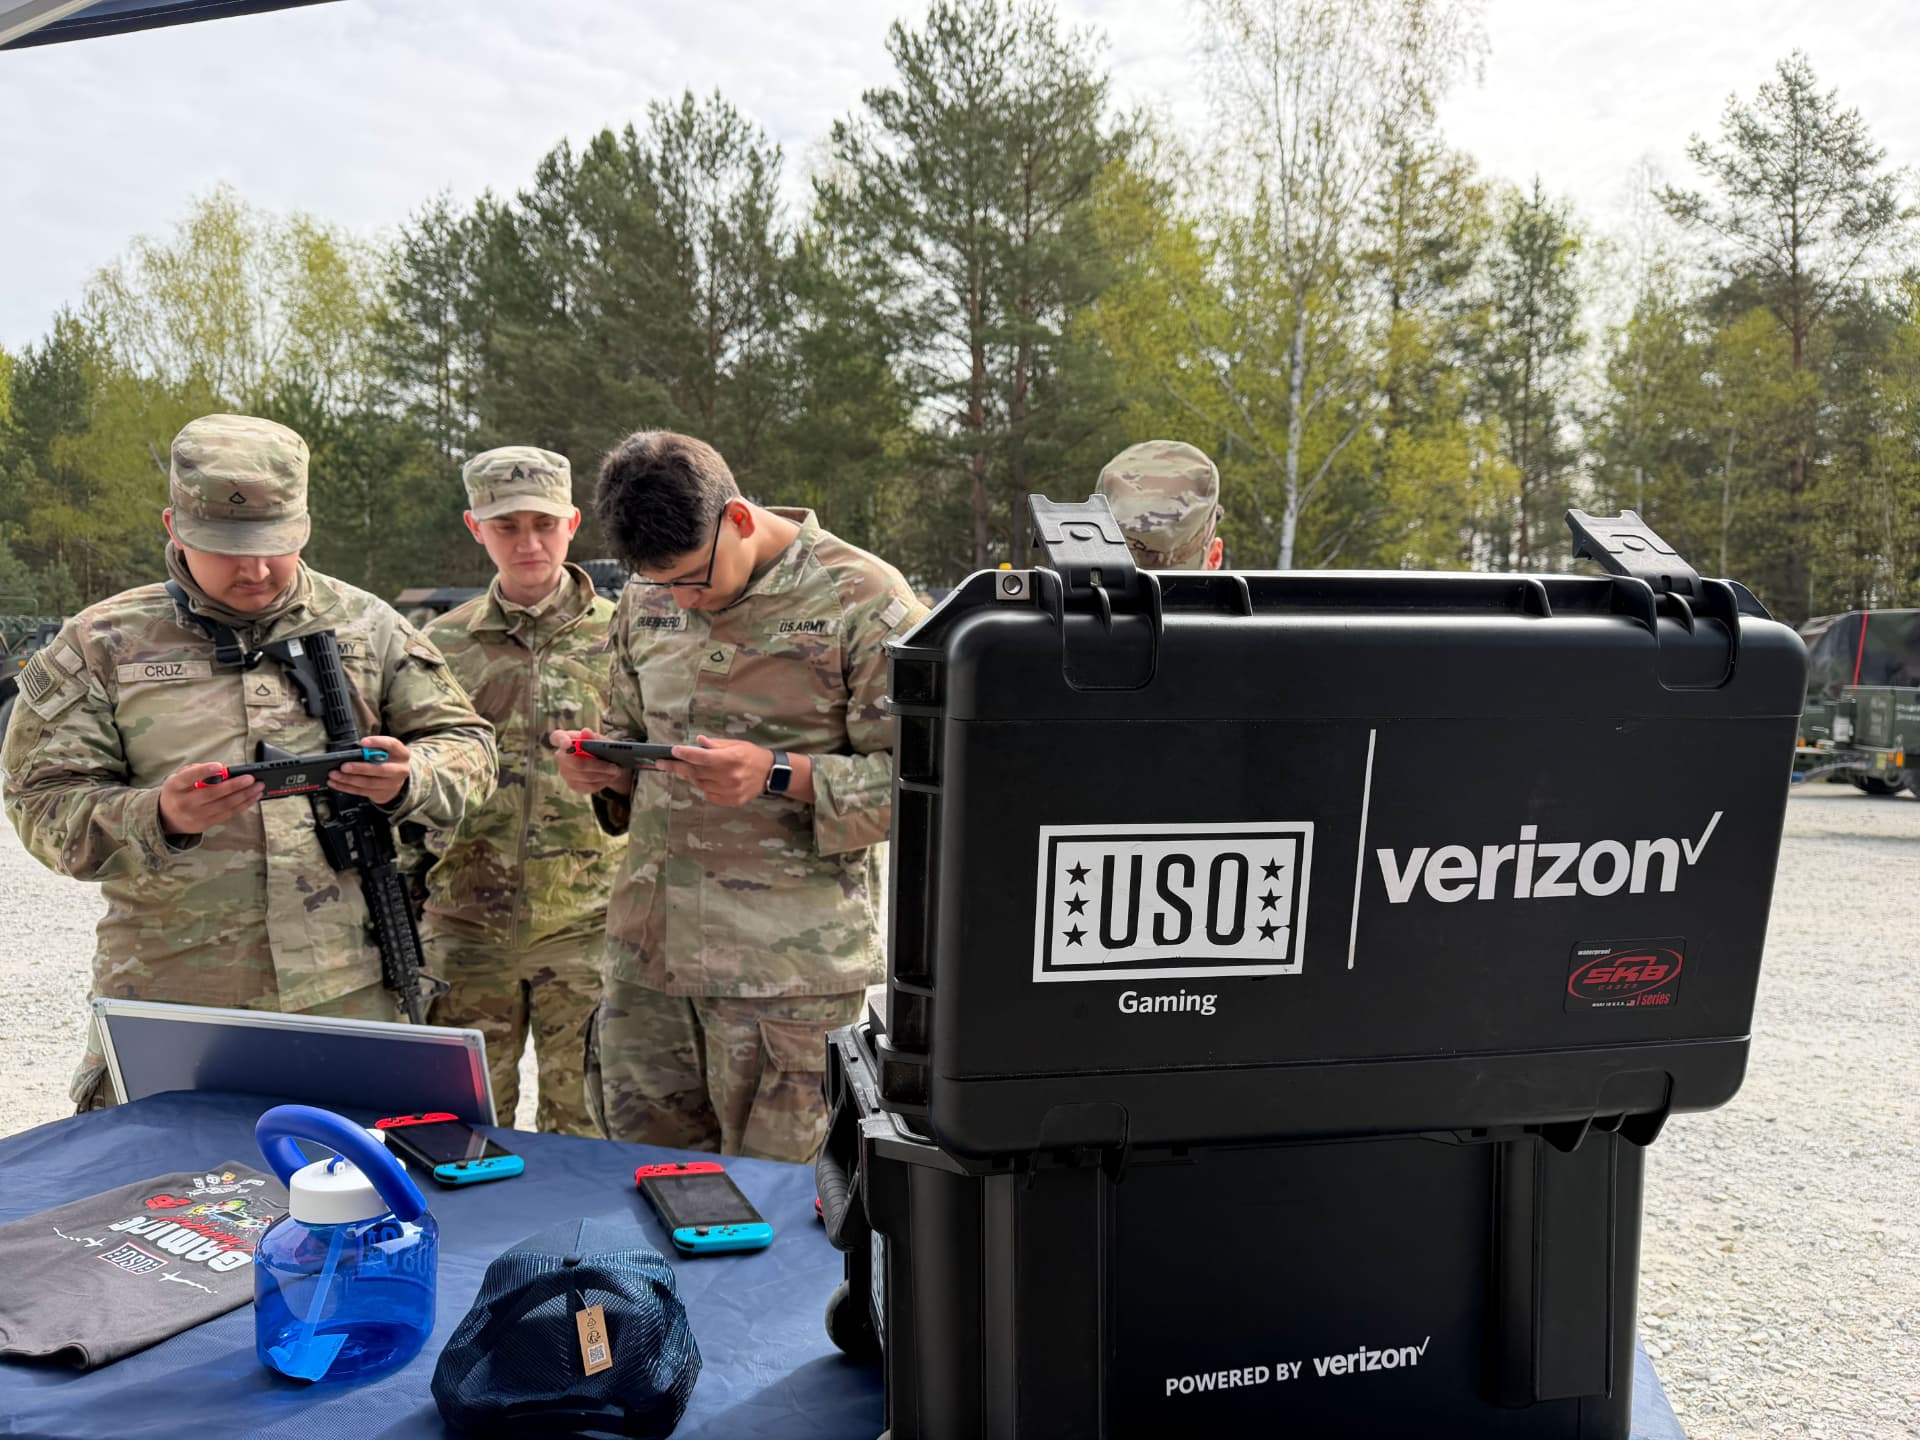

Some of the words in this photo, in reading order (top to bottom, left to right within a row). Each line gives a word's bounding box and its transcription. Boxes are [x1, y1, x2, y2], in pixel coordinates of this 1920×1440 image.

[337, 643, 356, 655] MY
[144, 664, 184, 677] CRUZ
[1376, 825, 1681, 904] verizon
[1099, 852, 1249, 949] USO
[1583, 964, 1670, 984] SKB
[1118, 989, 1218, 1016] Gaming
[112, 1250, 153, 1272] USO
[1166, 1366, 1270, 1397] POWERED
[1276, 1361, 1302, 1381] BY
[1313, 1345, 1418, 1377] verizon
